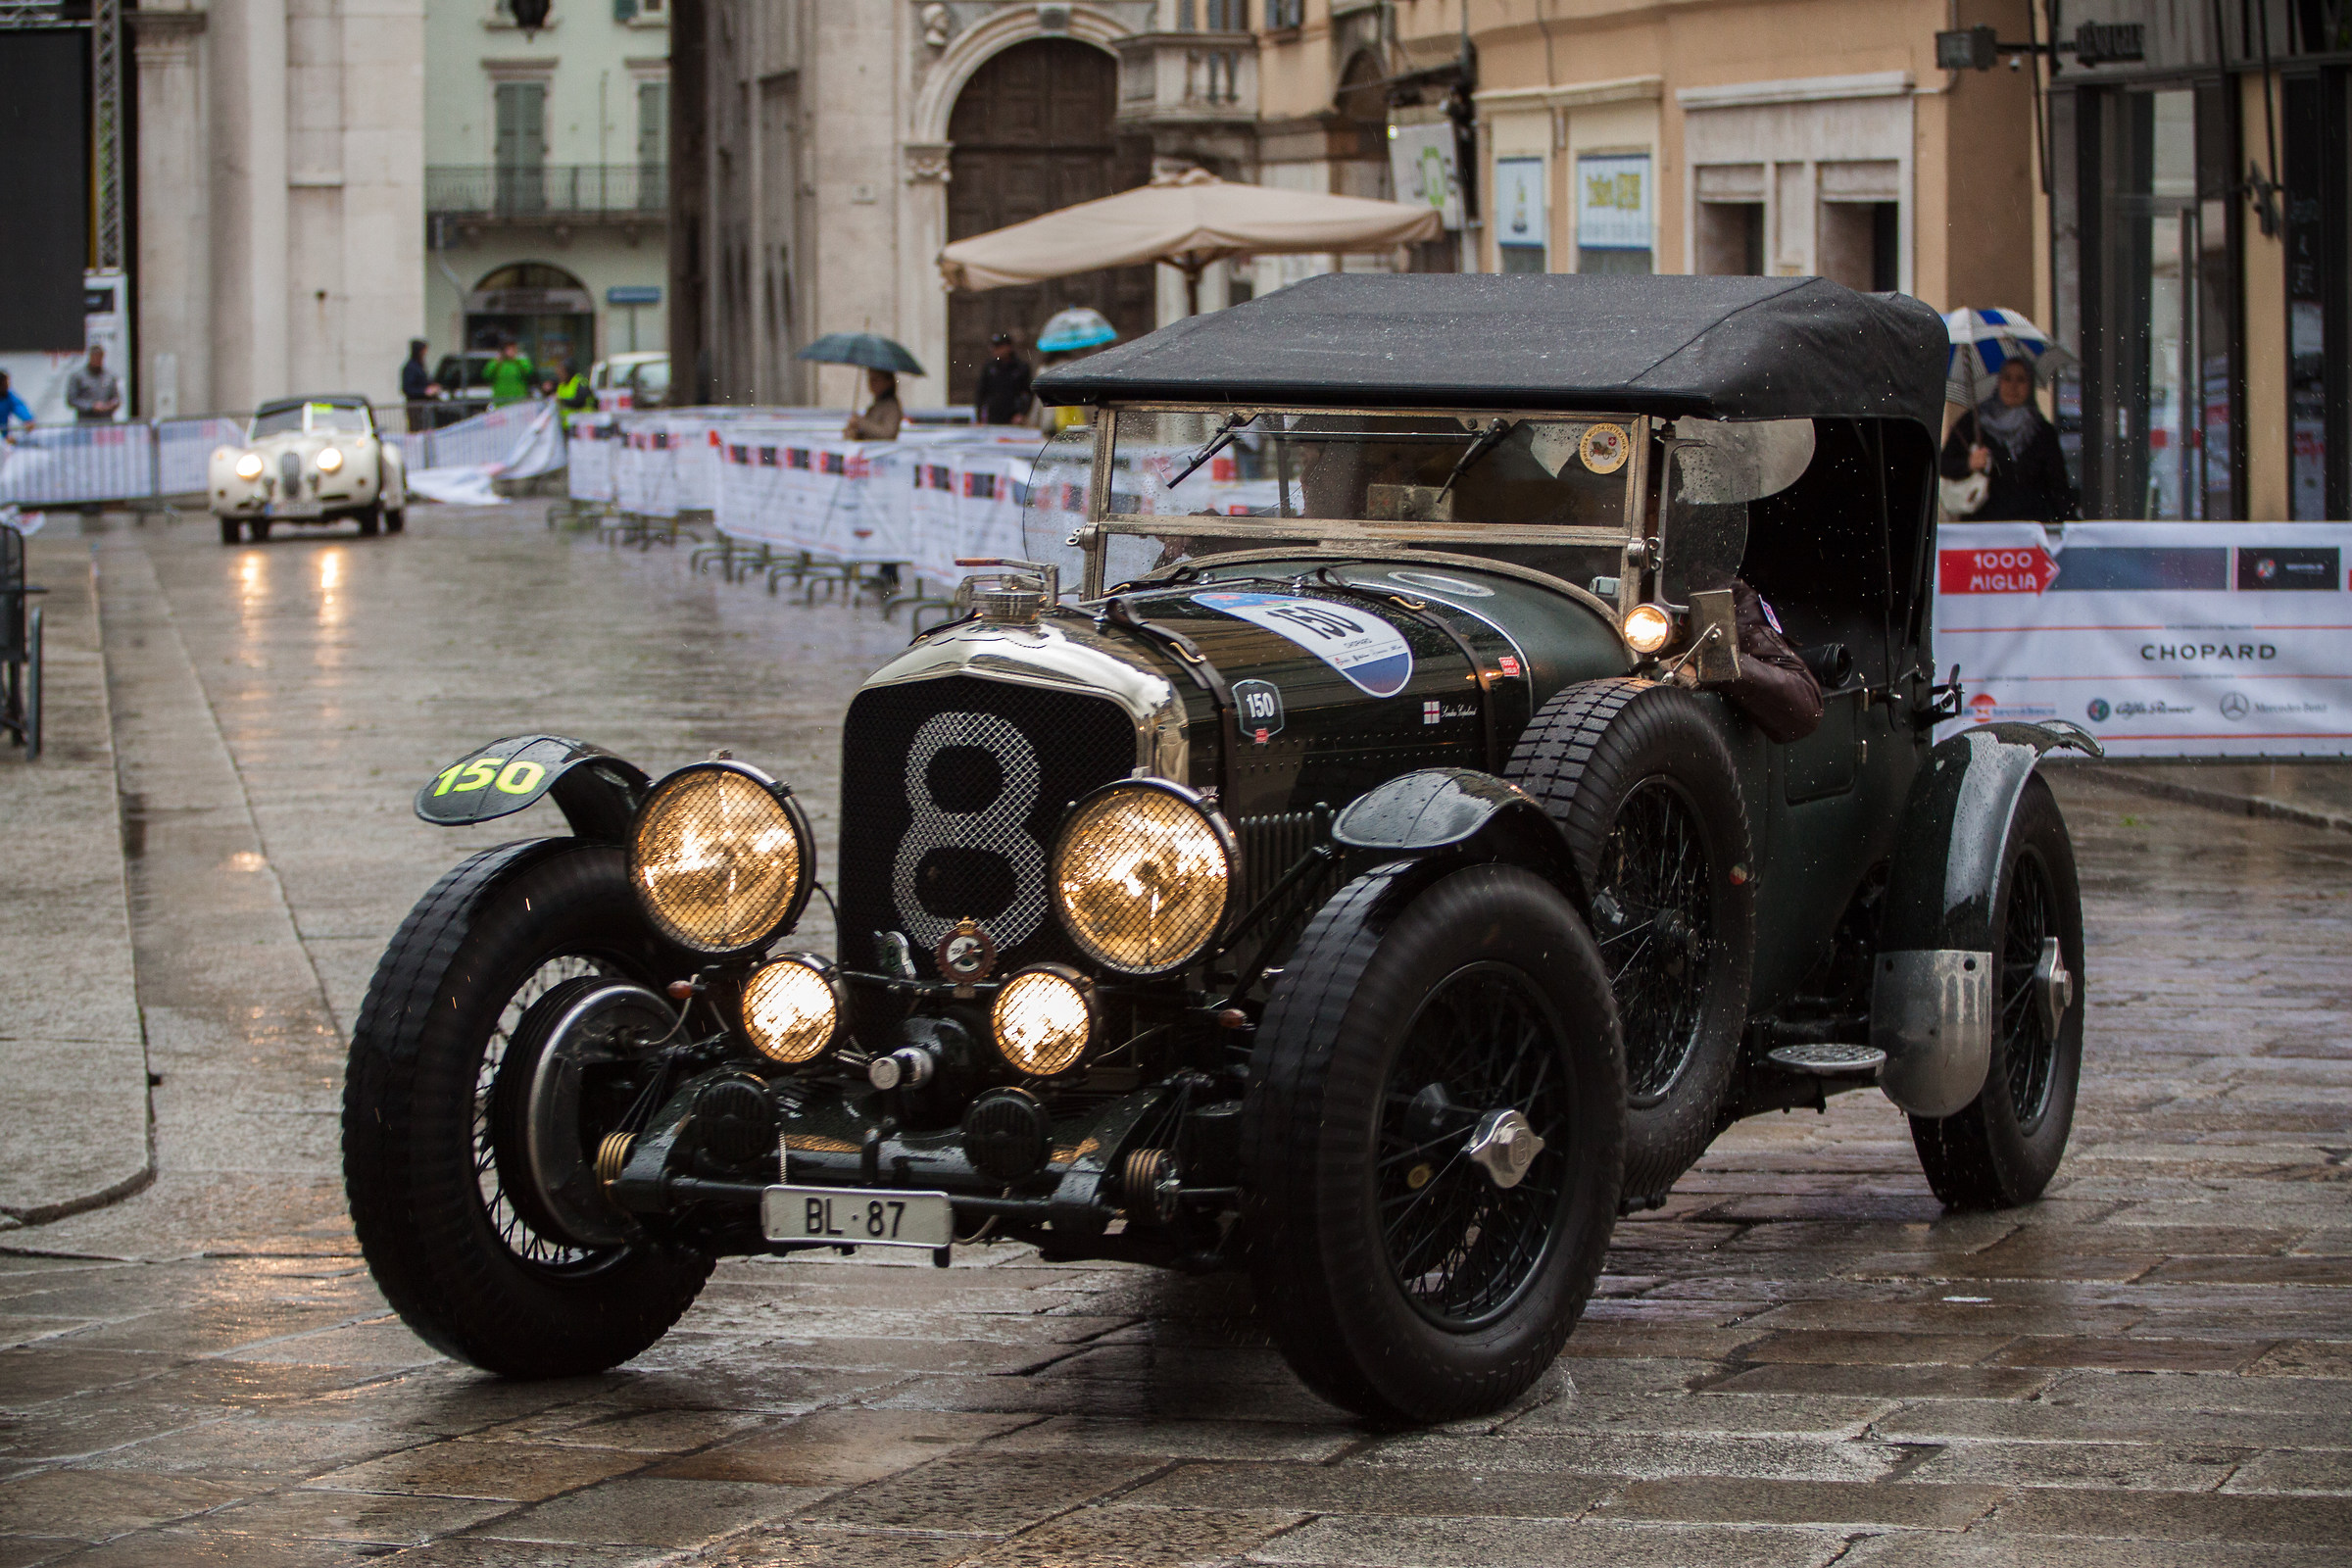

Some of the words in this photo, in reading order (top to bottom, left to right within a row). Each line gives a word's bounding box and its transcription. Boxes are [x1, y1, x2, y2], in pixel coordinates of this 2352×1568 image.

[1973, 552, 2033, 569] 1000
[1969, 572, 2037, 591] MIGLIA
[1265, 607, 1364, 640] 150
[2140, 643, 2278, 661] CHOPARD
[1246, 692, 1275, 718] 150
[433, 758, 546, 797] 150
